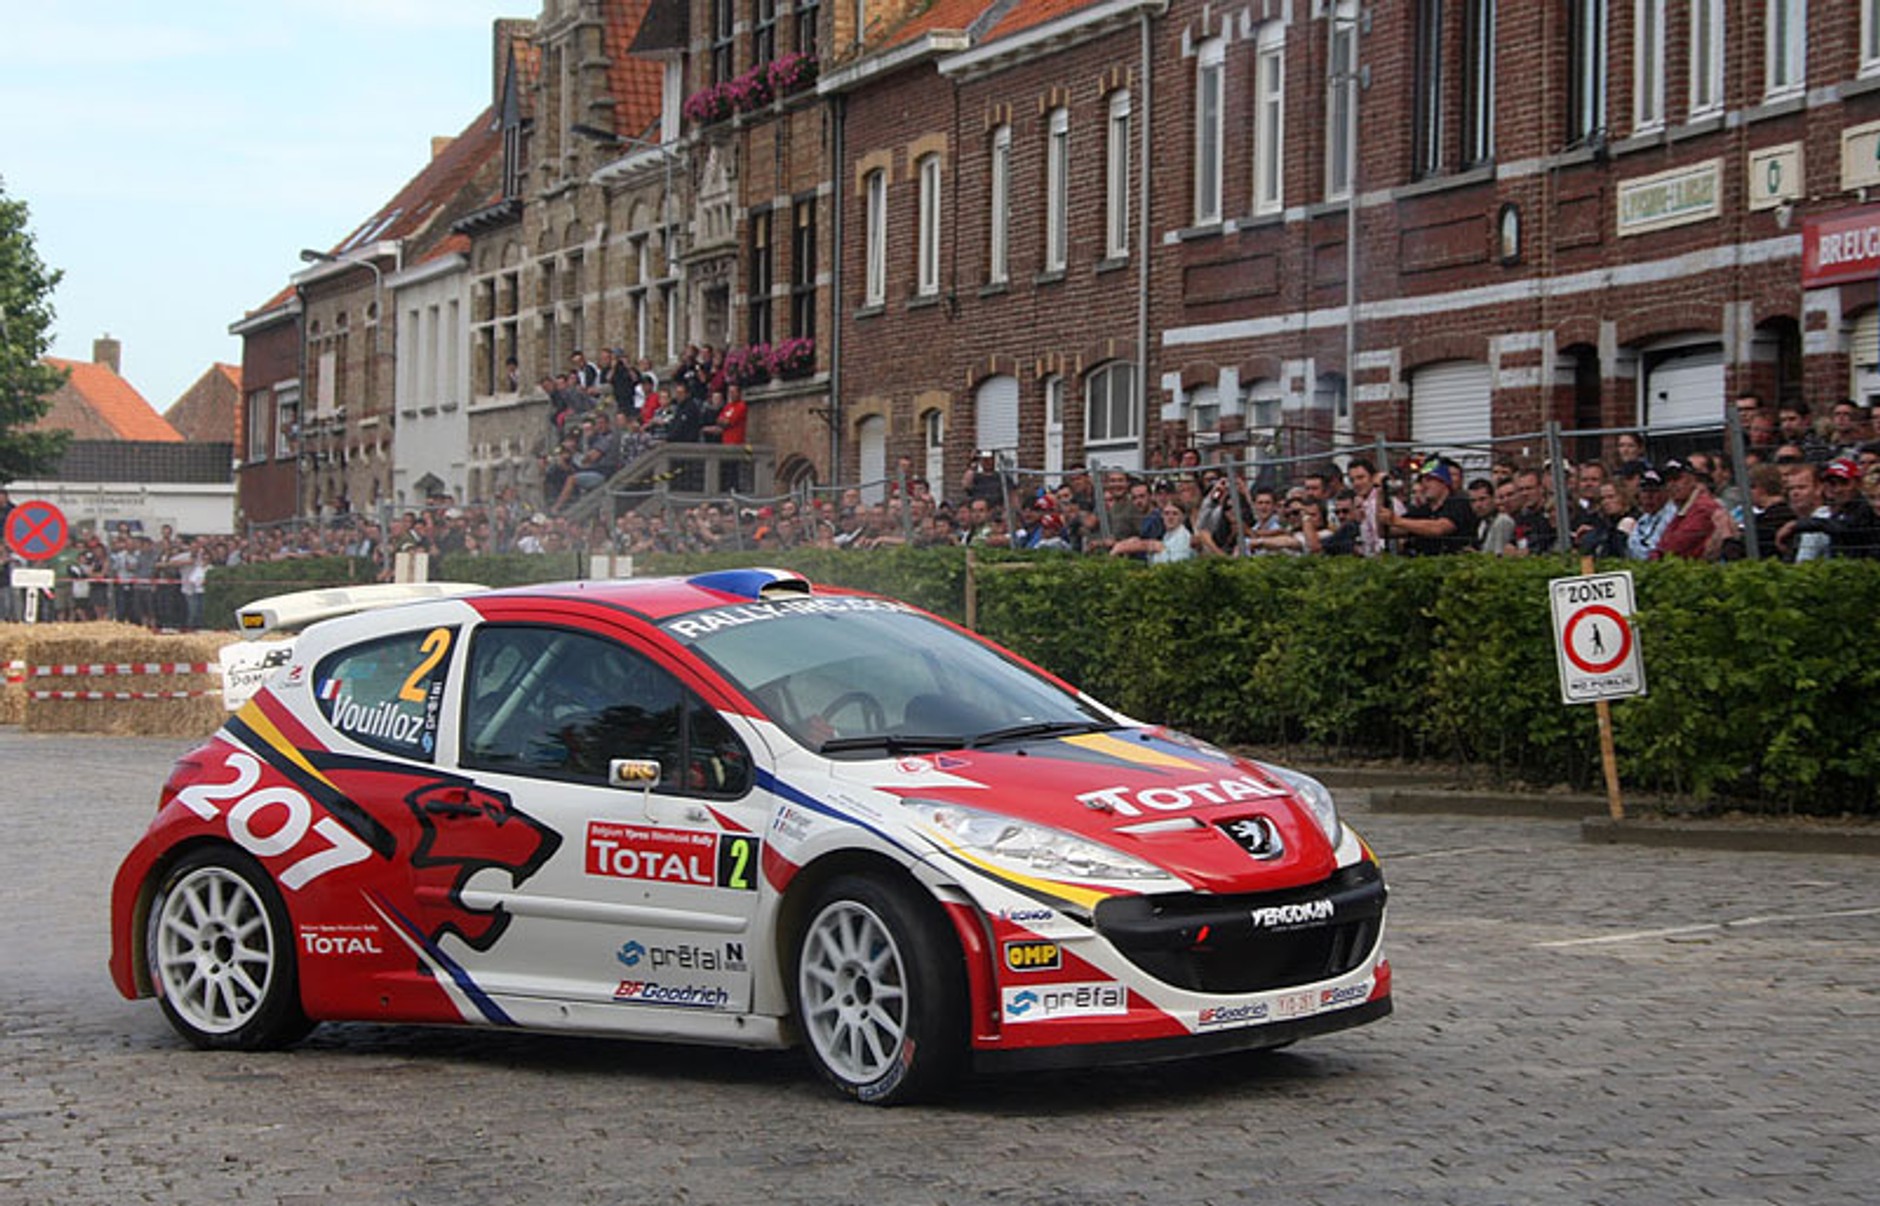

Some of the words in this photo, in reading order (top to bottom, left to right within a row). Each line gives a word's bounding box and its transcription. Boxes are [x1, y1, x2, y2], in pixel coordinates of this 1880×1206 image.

[1567, 581, 1615, 603] ZONE
[399, 627, 452, 703] 2
[332, 693, 424, 743] Vouilloz
[1074, 776, 1287, 816] TOTAL
[176, 752, 373, 891] 207
[590, 839, 712, 883] TOTAL
[729, 838, 750, 889] 2
[300, 932, 383, 954] TOTAL
[1010, 944, 1057, 966] OMP
[615, 980, 729, 1005] BFGoodrich
